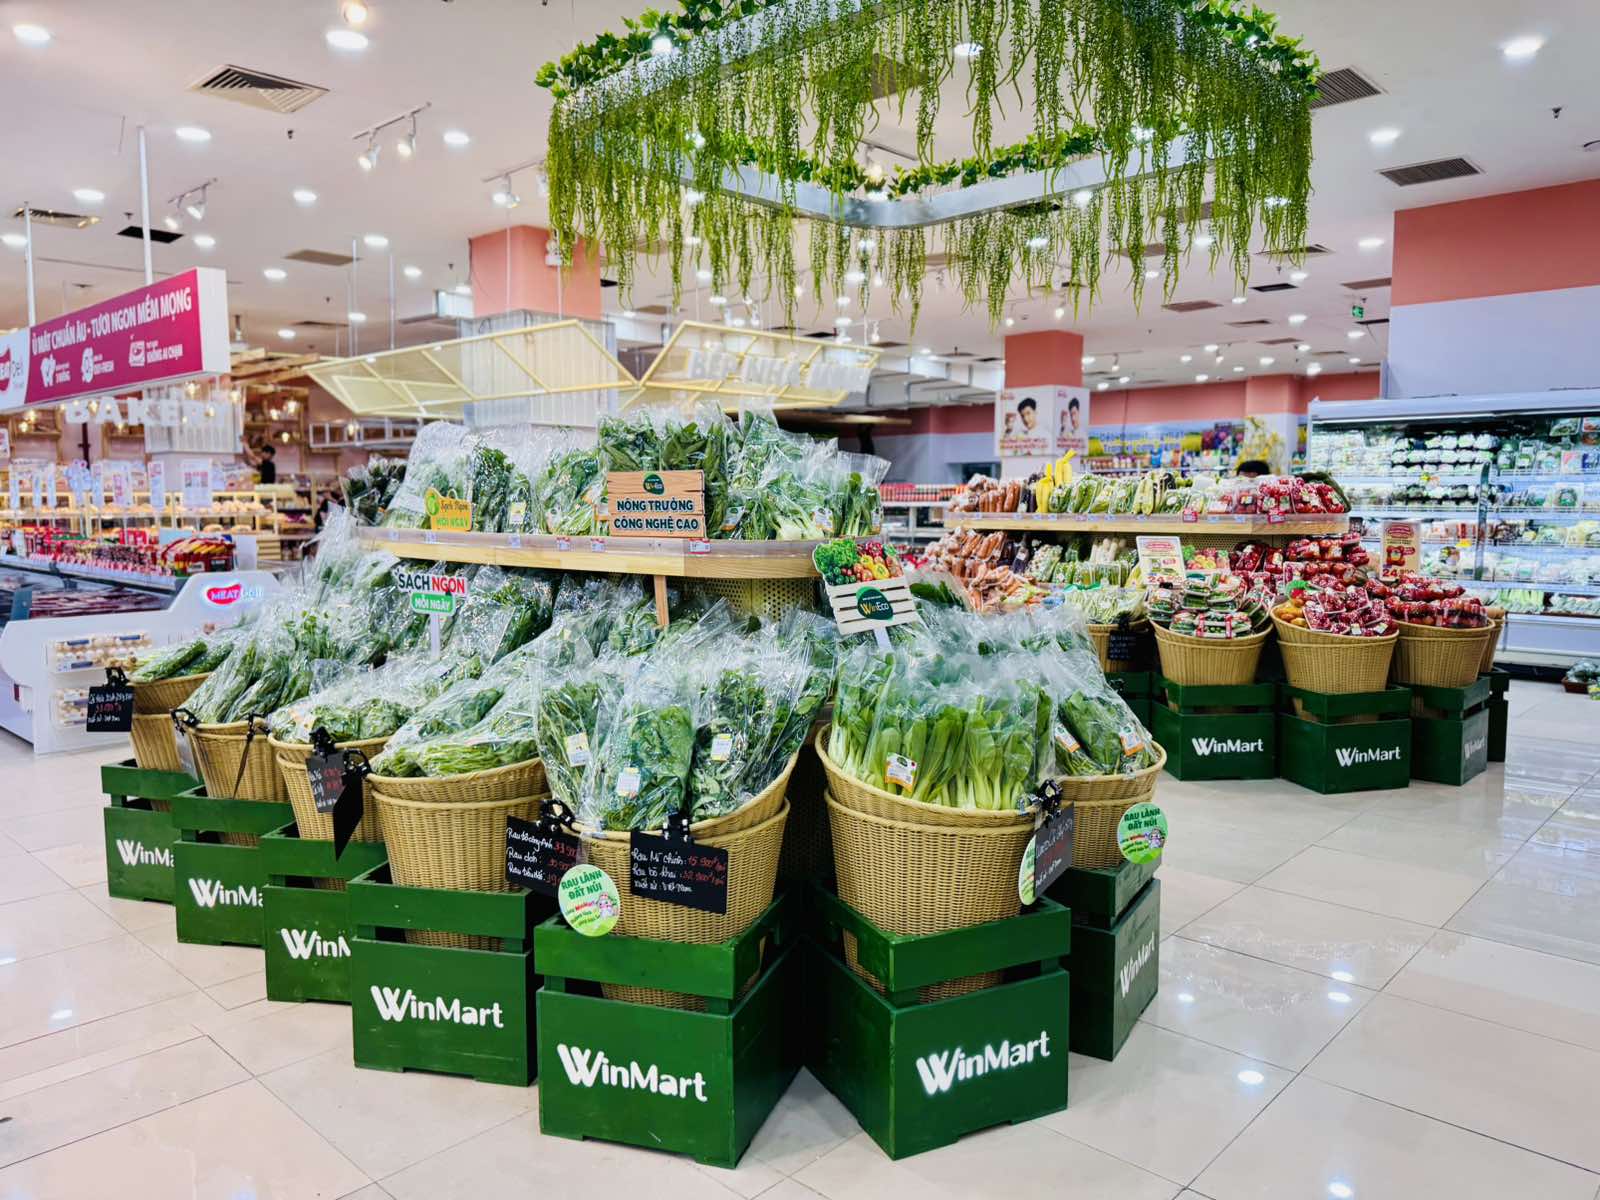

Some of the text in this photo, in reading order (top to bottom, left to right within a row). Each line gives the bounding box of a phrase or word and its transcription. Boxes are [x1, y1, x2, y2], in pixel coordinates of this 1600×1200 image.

[91, 312, 111, 338] TƯƠI
[111, 305, 136, 332] NGON
[160, 287, 192, 322] MỌNG
[617, 497, 694, 511] NÔNG TRƯỜNG
[614, 516, 699, 532] CÔNG NGHỆ CAO
[432, 576, 465, 594] NGON
[1191, 737, 1264, 756] WinMart
[1335, 746, 1401, 767] WinMart
[1124, 807, 1161, 822] RAU LÀNH
[506, 827, 521, 840] Rau
[506, 847, 523, 859] Rau
[631, 848, 648, 862] Rau
[508, 862, 522, 875] Rau
[632, 863, 646, 876] Rau
[561, 870, 602, 890] RAU LÀNH
[568, 881, 603, 900] ĐẤT NÚI
[1120, 931, 1155, 998] WinMart
[370, 985, 504, 1028] WinMart
[916, 1030, 1050, 1095] WinMart
[556, 1043, 708, 1102] WinMart
